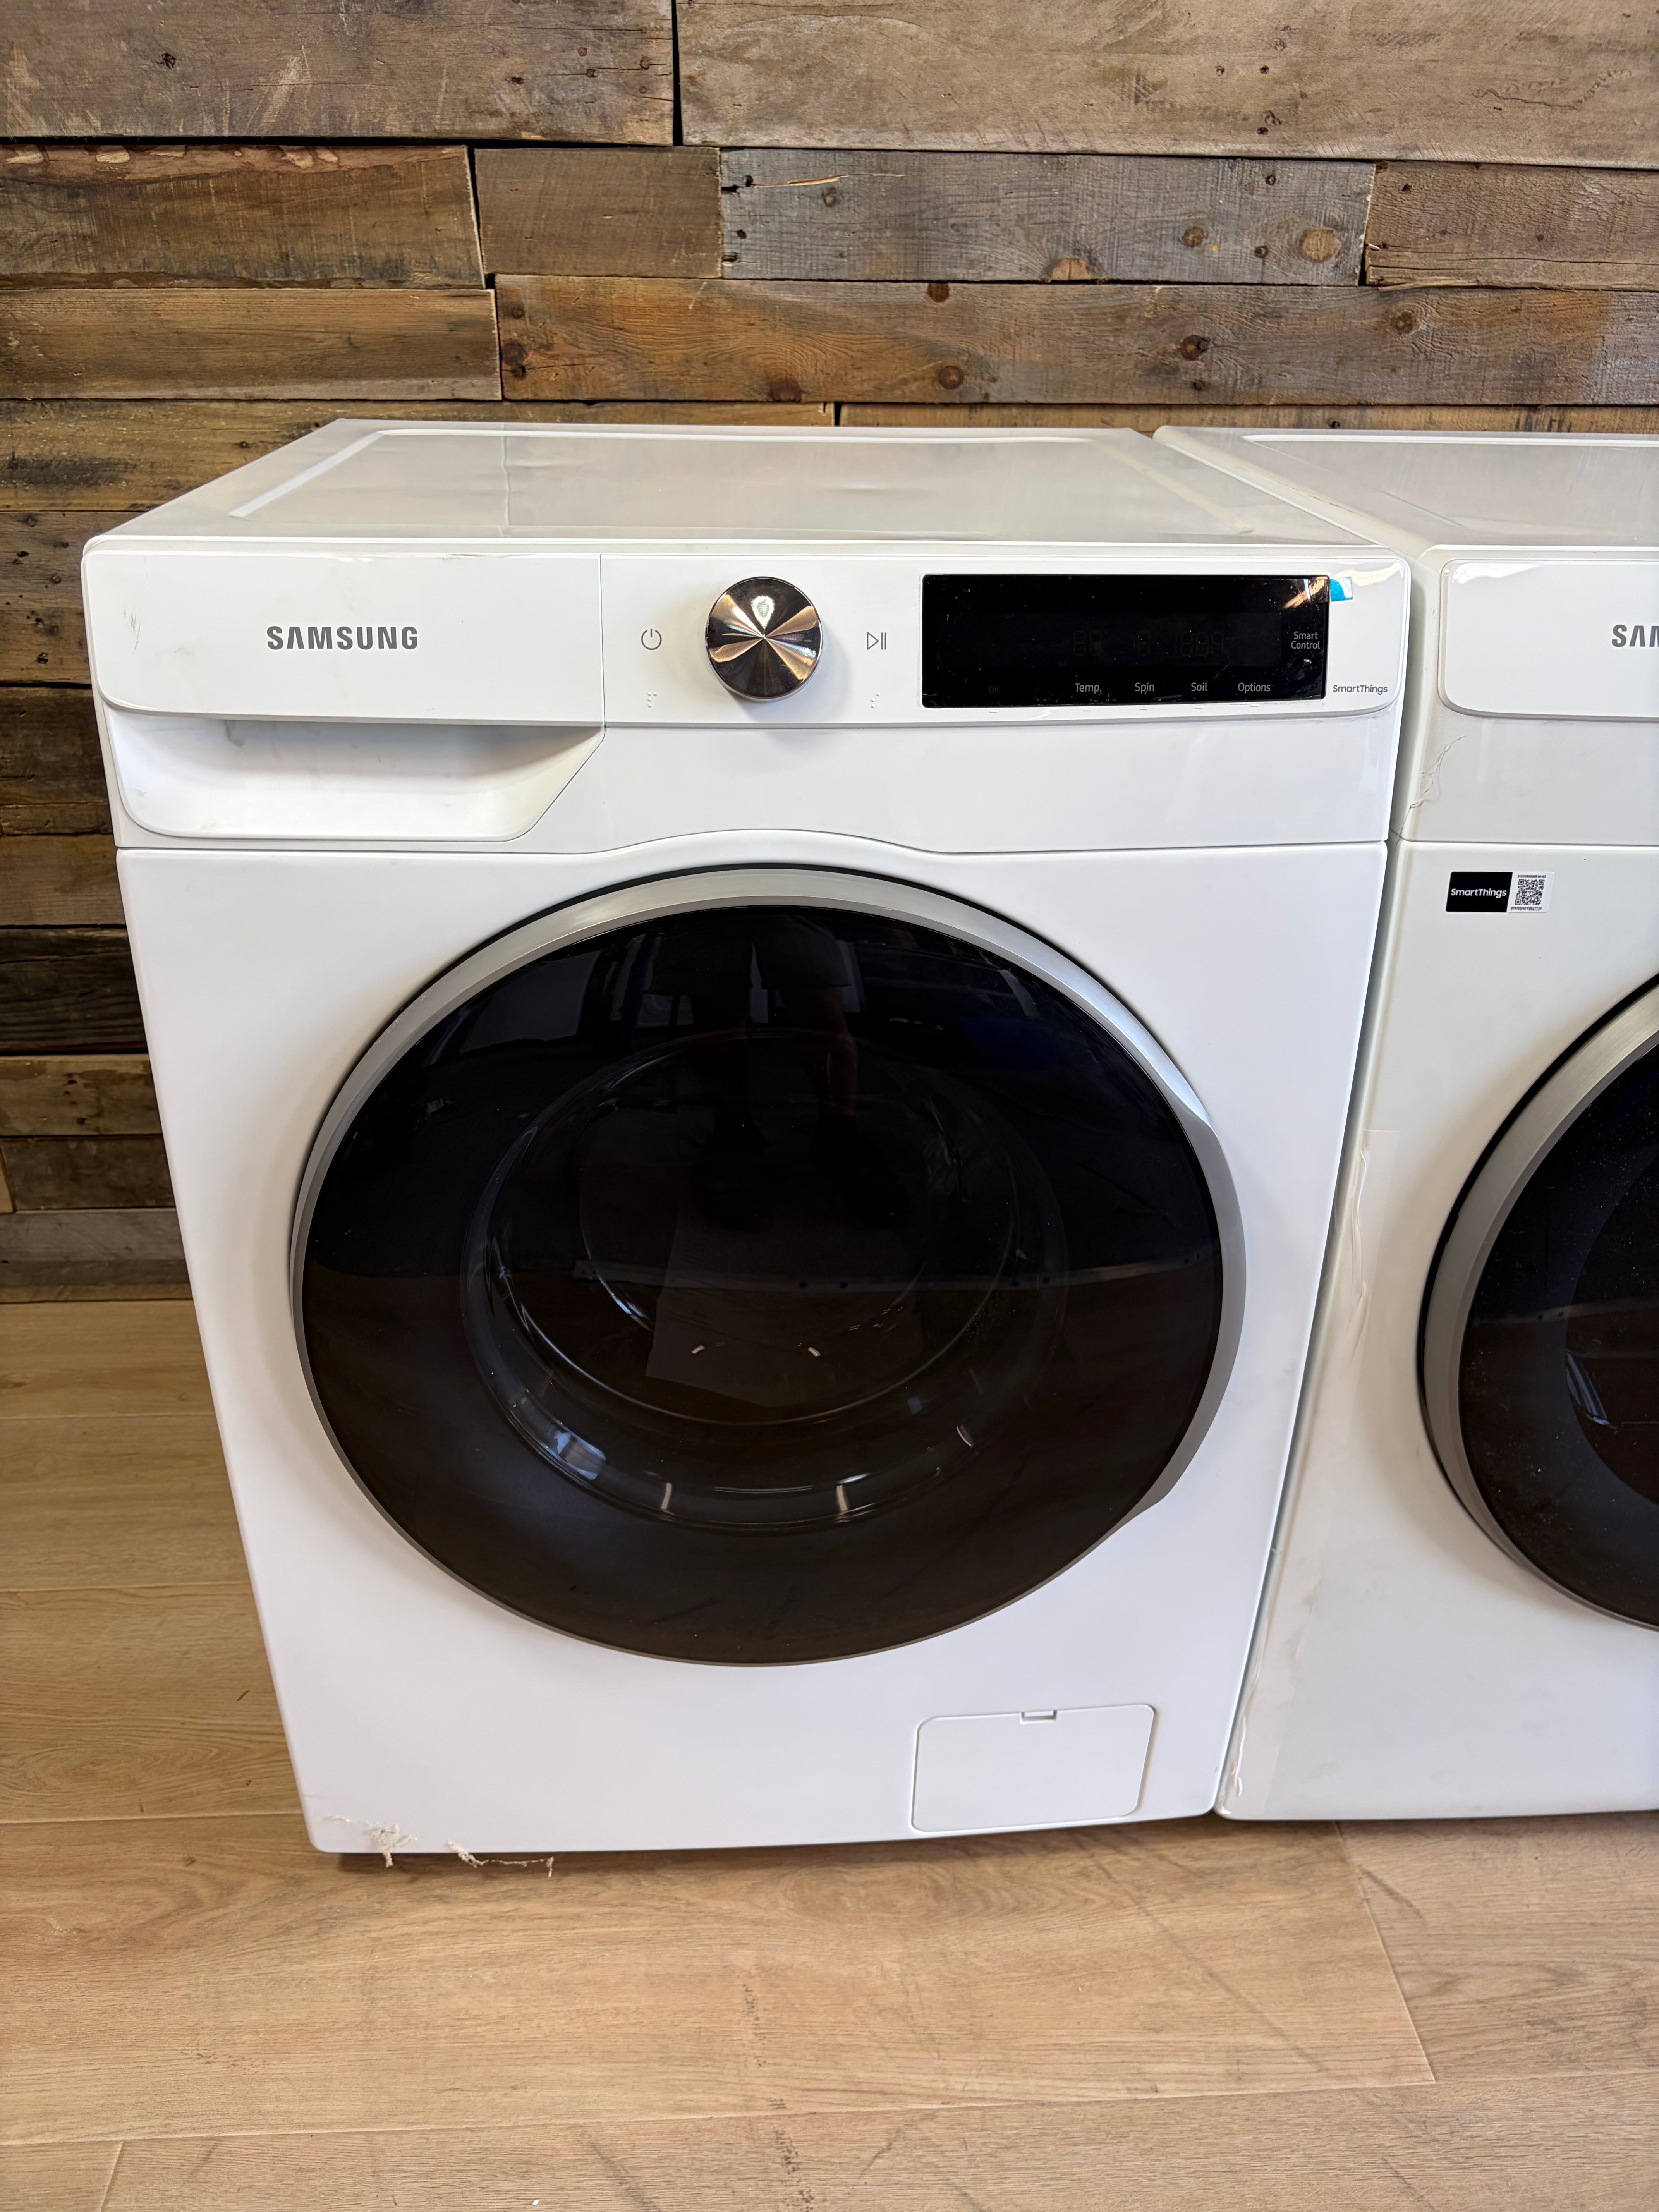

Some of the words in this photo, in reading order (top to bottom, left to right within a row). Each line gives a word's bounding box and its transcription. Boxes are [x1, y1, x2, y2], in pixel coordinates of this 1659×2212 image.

[267, 626, 417, 650] SAMSUNG
[1293, 631, 1318, 640] Smart
[1291, 640, 1320, 650] Control
[988, 685, 1000, 694] OK
[1074, 683, 1102, 694] Temp.
[1135, 682, 1155, 694] Spin
[1191, 682, 1208, 692] Soil
[1238, 682, 1271, 694] Options
[1333, 684, 1388, 695] SmartThings
[1450, 888, 1507, 898] SmartThings
